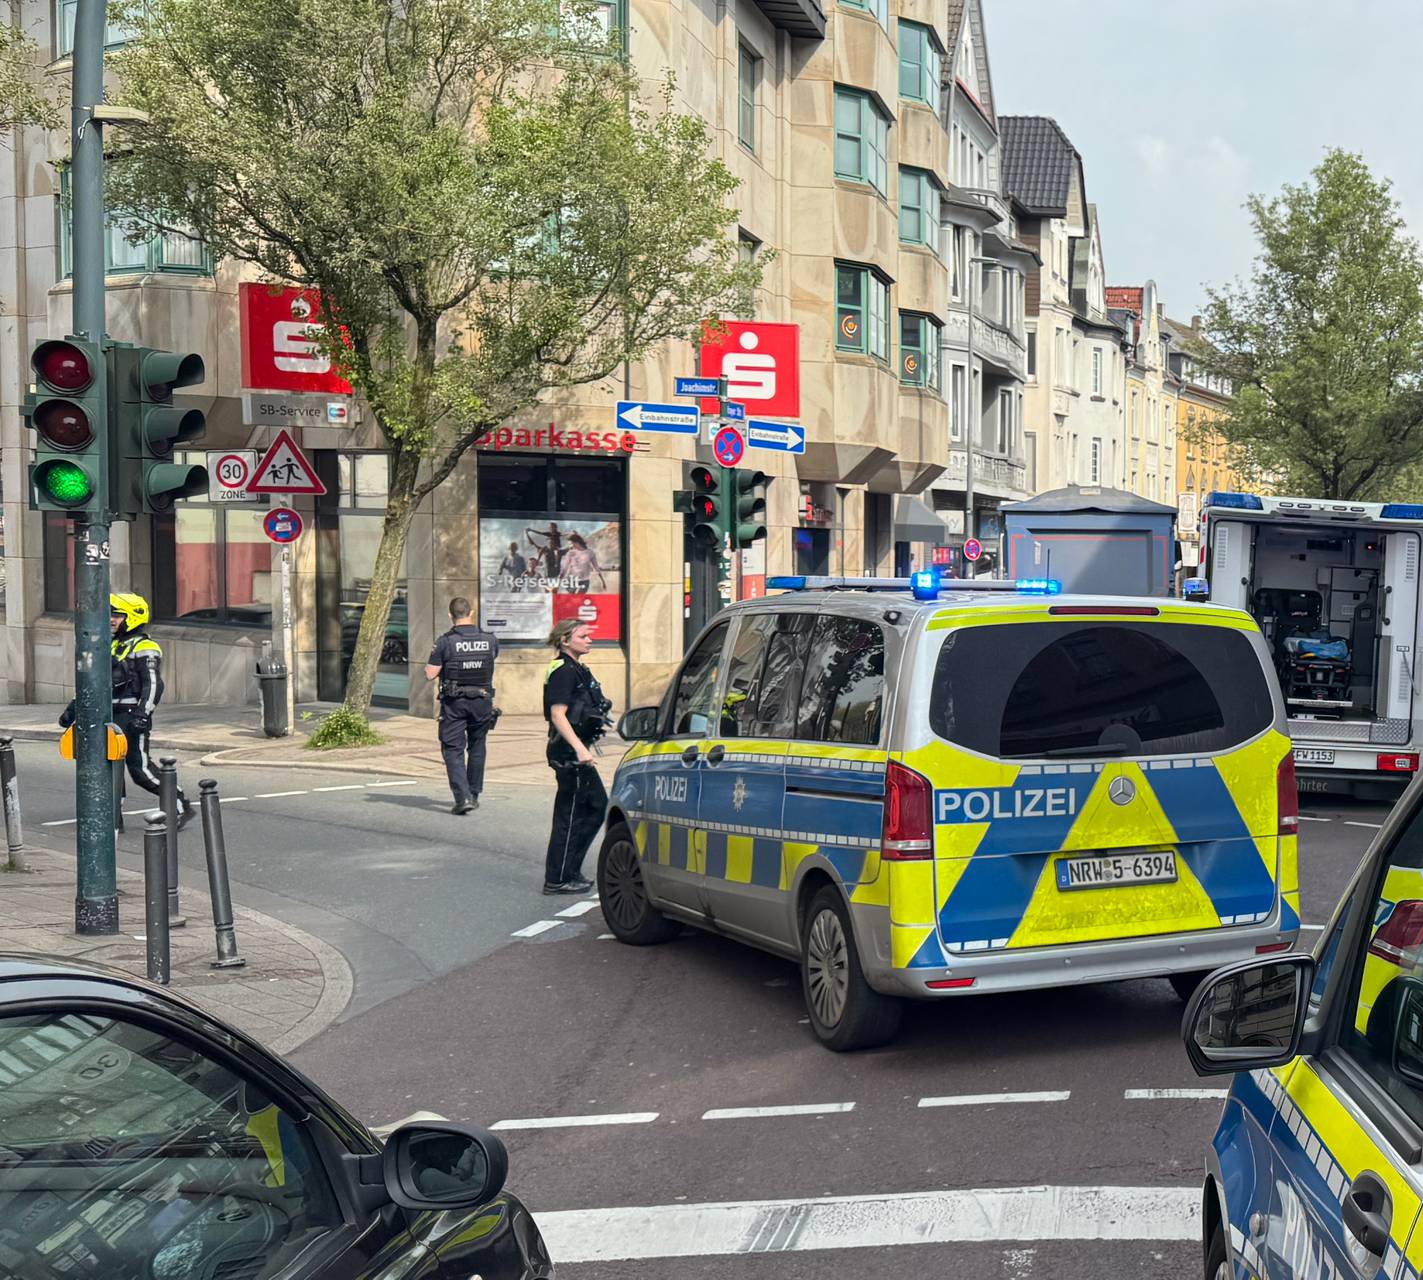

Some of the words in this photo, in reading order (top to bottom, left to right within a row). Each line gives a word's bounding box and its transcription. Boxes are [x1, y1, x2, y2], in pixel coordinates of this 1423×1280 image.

[680, 382, 718, 394] Joachimstr.
[260, 404, 321, 417] SB-Service
[640, 413, 694, 424] Einbahnstraße
[221, 464, 242, 480] 30
[220, 490, 246, 500] ZONE
[487, 574, 586, 590] S-Reisewelt.
[456, 641, 490, 652] POLIZEI
[462, 660, 483, 669] NRW
[1310, 751, 1333, 761] 1153
[655, 775, 688, 802] POLIZEI
[938, 787, 1076, 821] POLIZEI
[1069, 862, 1103, 882] NRW
[1113, 856, 1174, 879] 5-6394
